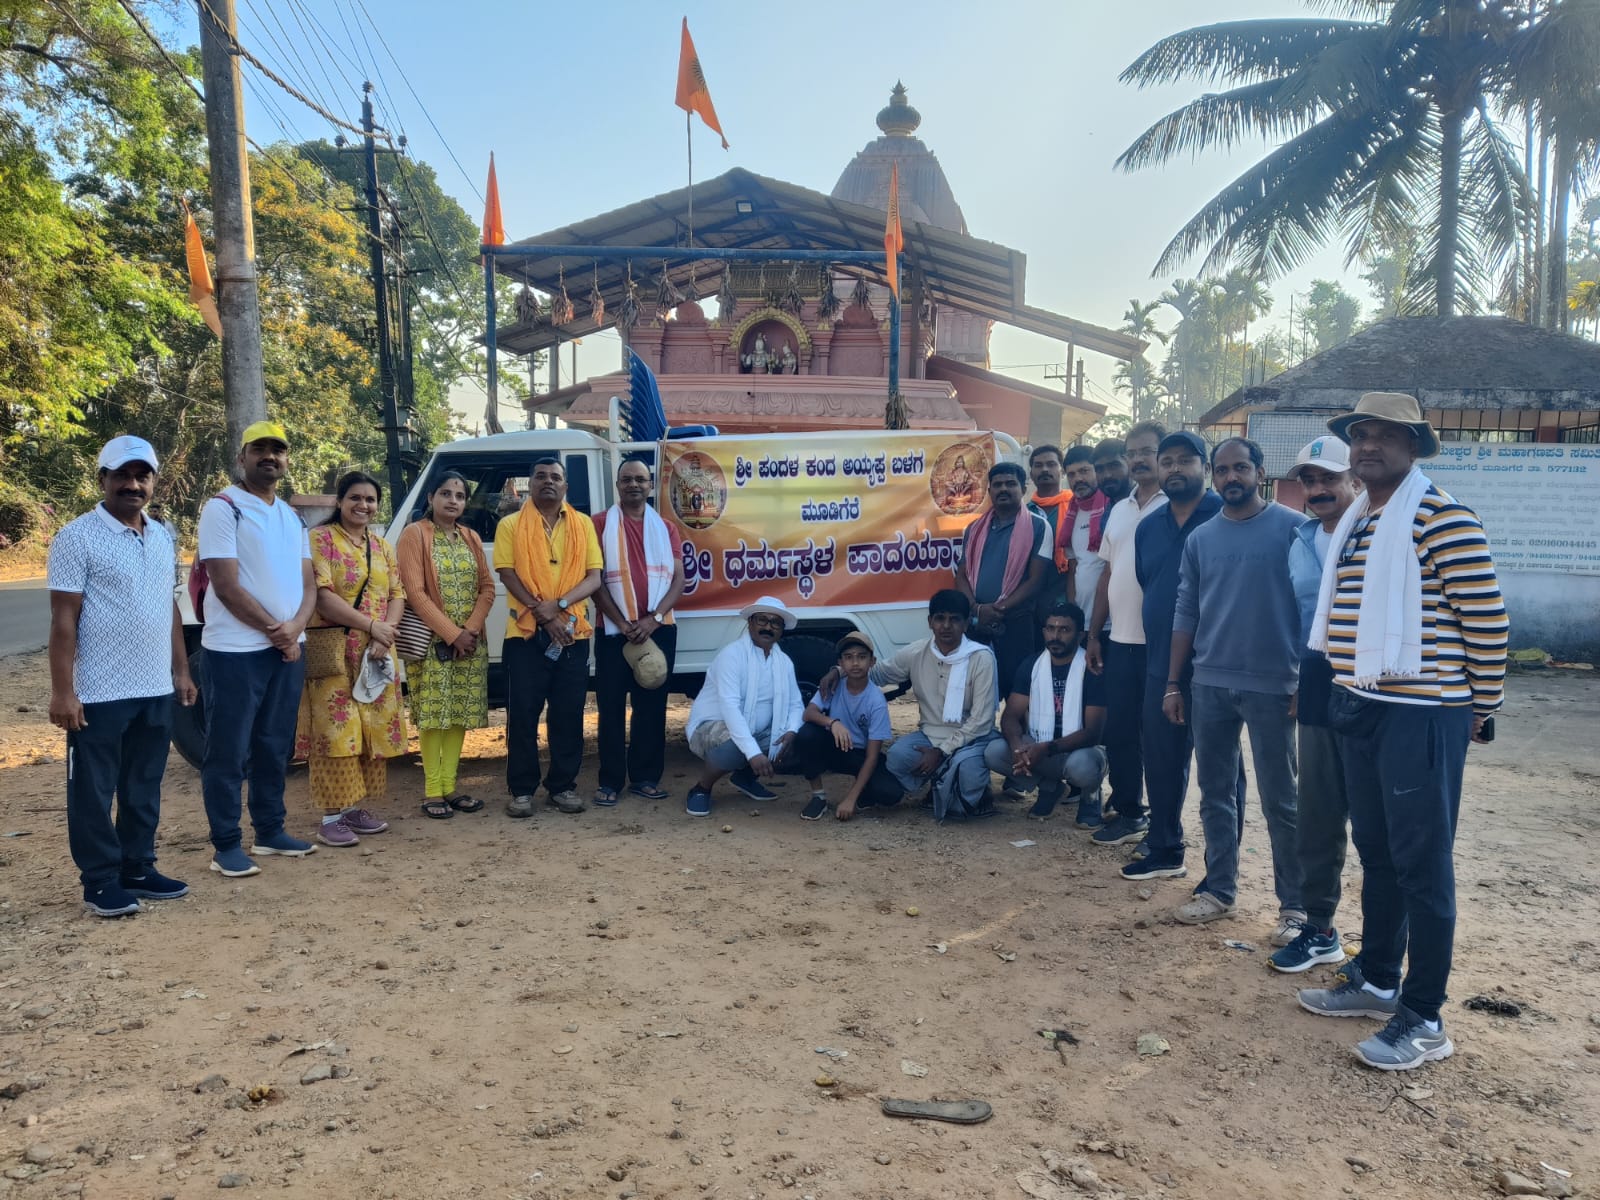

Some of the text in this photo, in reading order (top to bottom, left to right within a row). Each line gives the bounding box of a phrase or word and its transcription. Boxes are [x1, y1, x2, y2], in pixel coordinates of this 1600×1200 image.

[734, 449, 924, 488] ಶ್ರೀ ಪಂದಳ ಕಂದ ಅಯ್ಯಪ್ಪ ಬಳಗ
[1477, 446, 1492, 461] ಶ್ರೀ
[1498, 447, 1564, 459] ಮಹಾಗಣಪತಿ
[801, 495, 860, 523] ಮೂಡಿಗೆರೆ
[682, 540, 713, 595] ಶ್ರೀ
[724, 536, 835, 599] ಧರ್ಮಸ್ಥಳ
